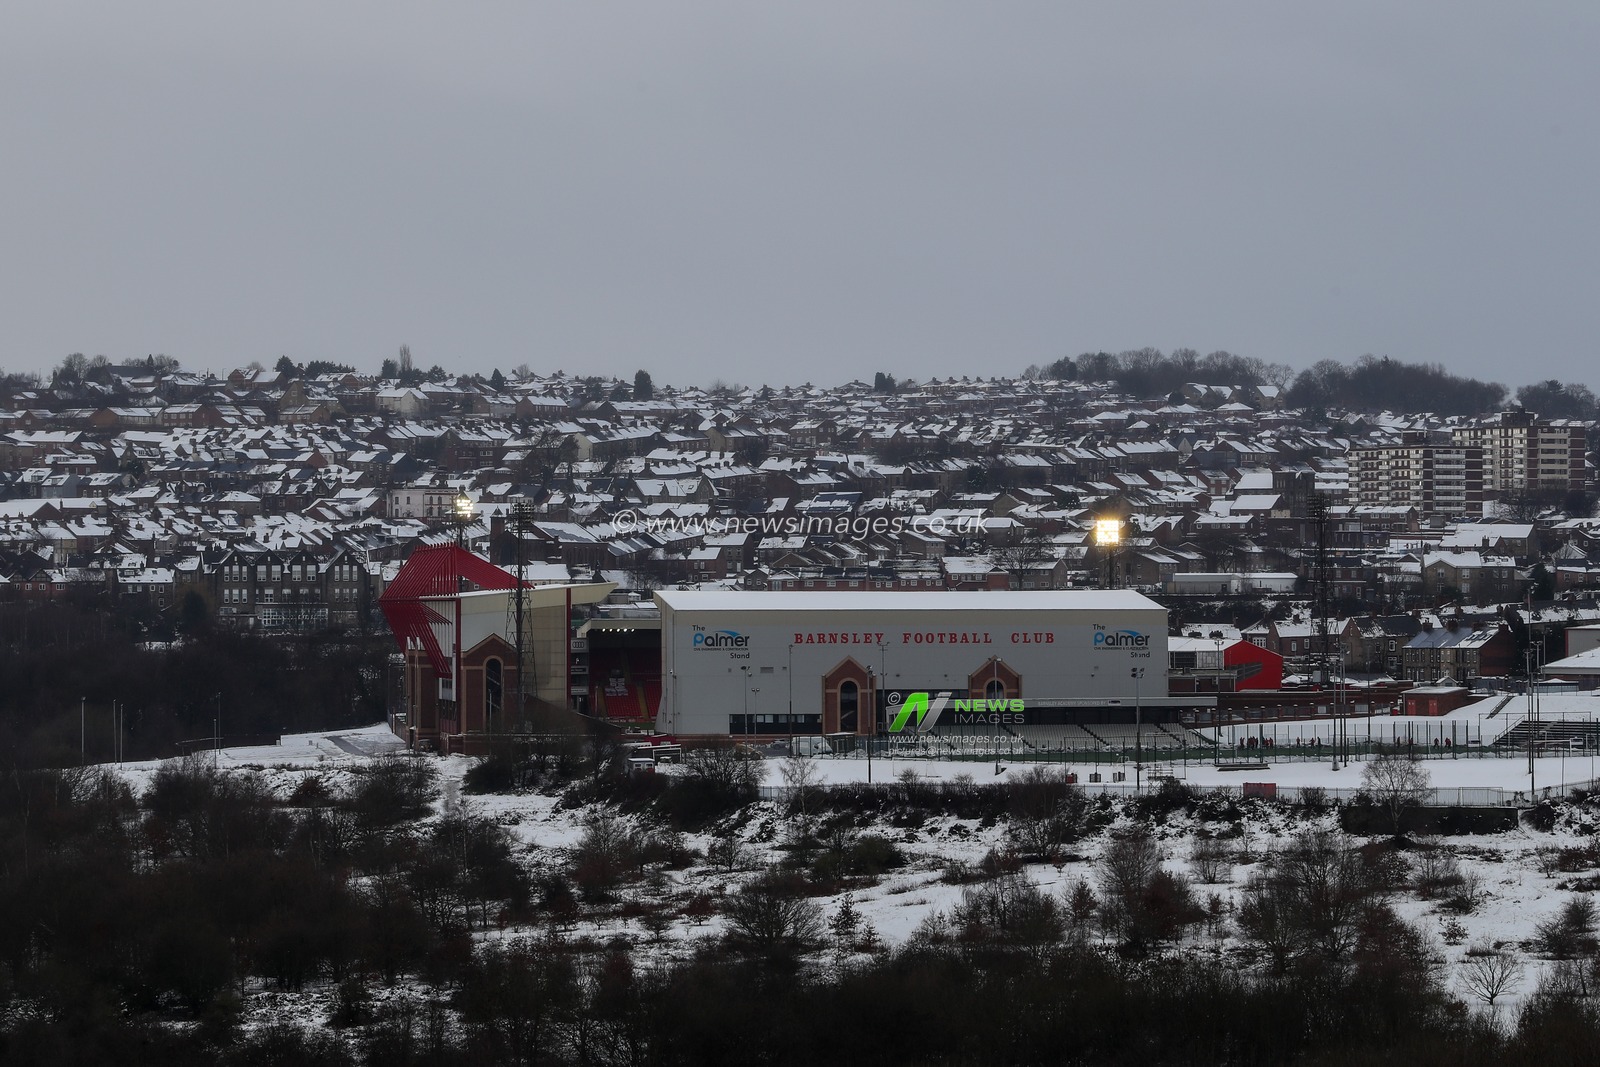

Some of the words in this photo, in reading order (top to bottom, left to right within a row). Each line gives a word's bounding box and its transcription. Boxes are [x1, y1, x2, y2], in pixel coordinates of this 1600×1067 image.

[693, 632, 750, 647] Palmer
[794, 633, 885, 644] BARNSLEY
[903, 633, 993, 644] FOOTBALL
[1011, 633, 1055, 644] CLUB
[1094, 631, 1150, 646] Palmer
